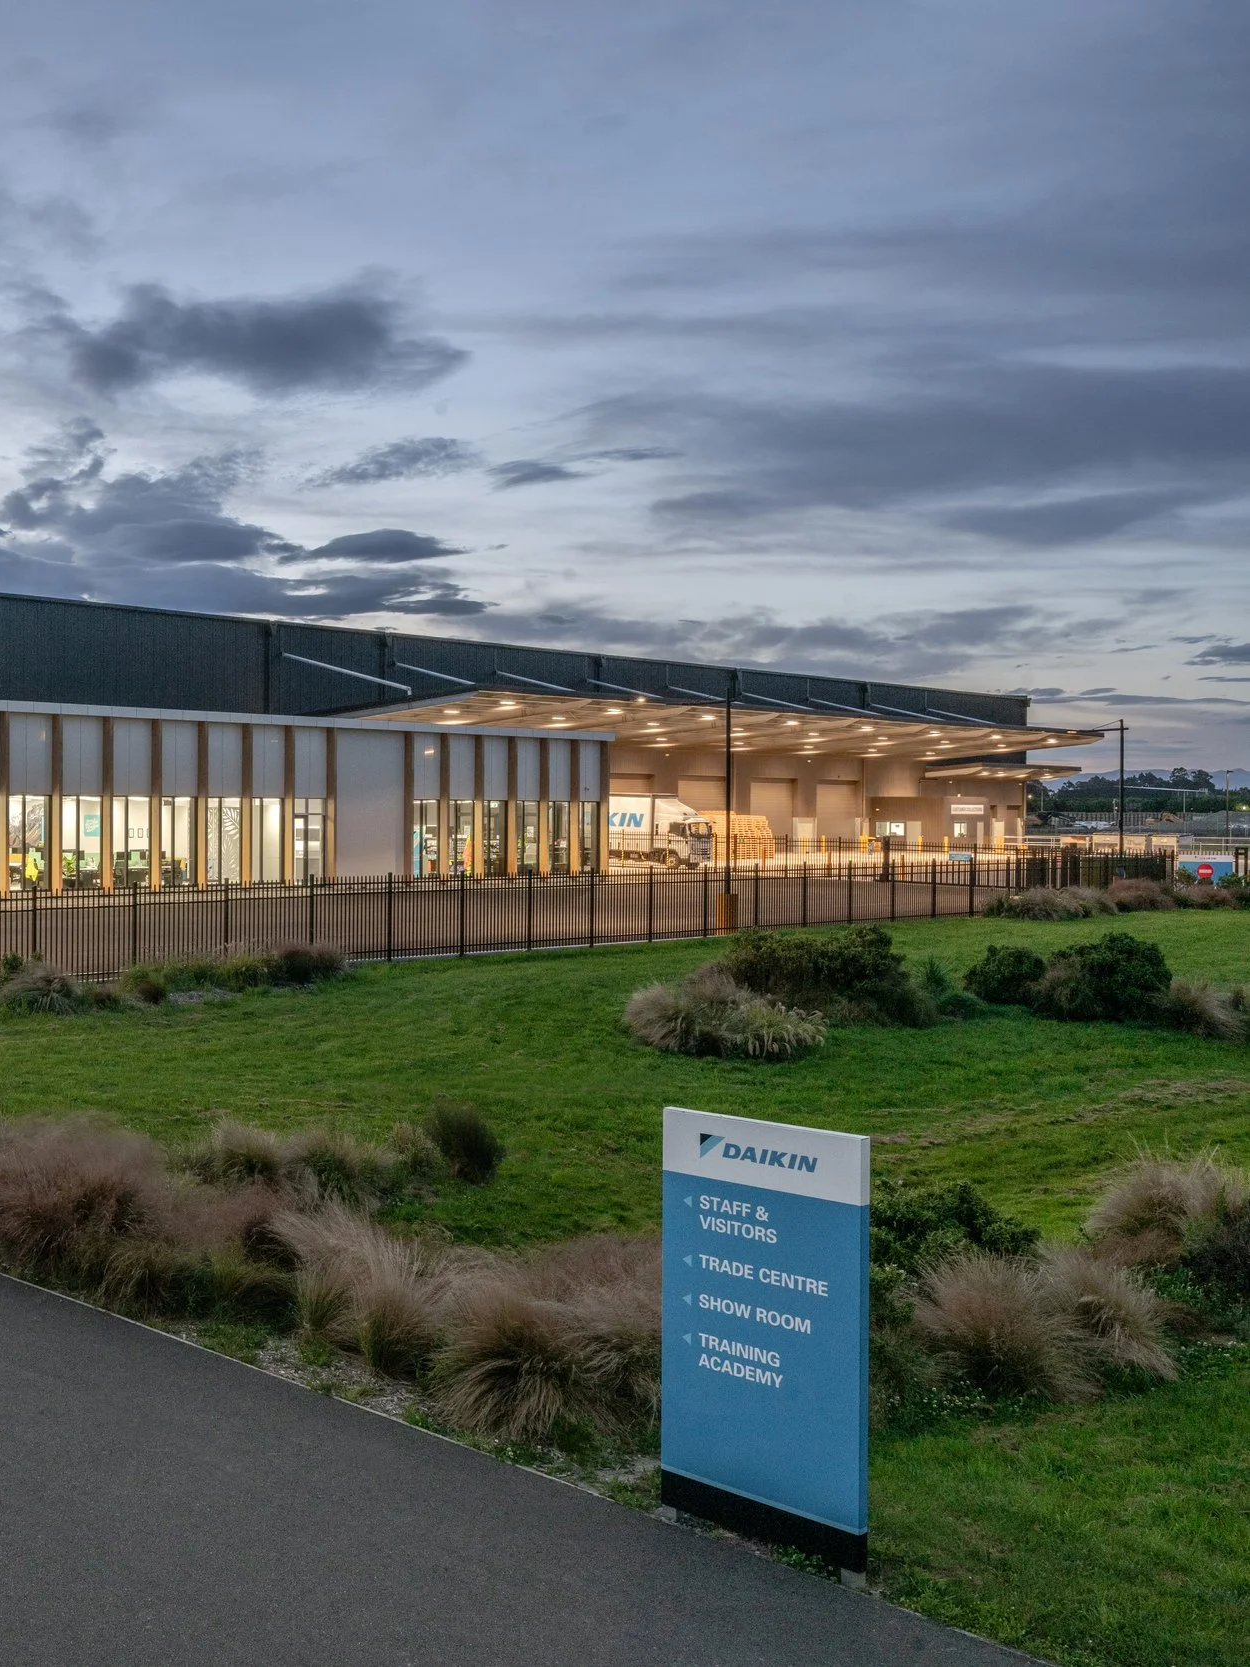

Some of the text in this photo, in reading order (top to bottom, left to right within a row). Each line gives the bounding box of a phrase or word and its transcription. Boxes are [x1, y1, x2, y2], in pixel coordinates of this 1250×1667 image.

[722, 1142, 818, 1173] DAIKIN
[699, 1195, 769, 1222] STAFF &
[699, 1214, 778, 1244] VISITORS
[699, 1254, 829, 1297] TRADE CENTRE
[698, 1294, 811, 1335] SHOW ROOM
[698, 1332, 781, 1368] TRAINING
[698, 1353, 784, 1389] ACADEMY
